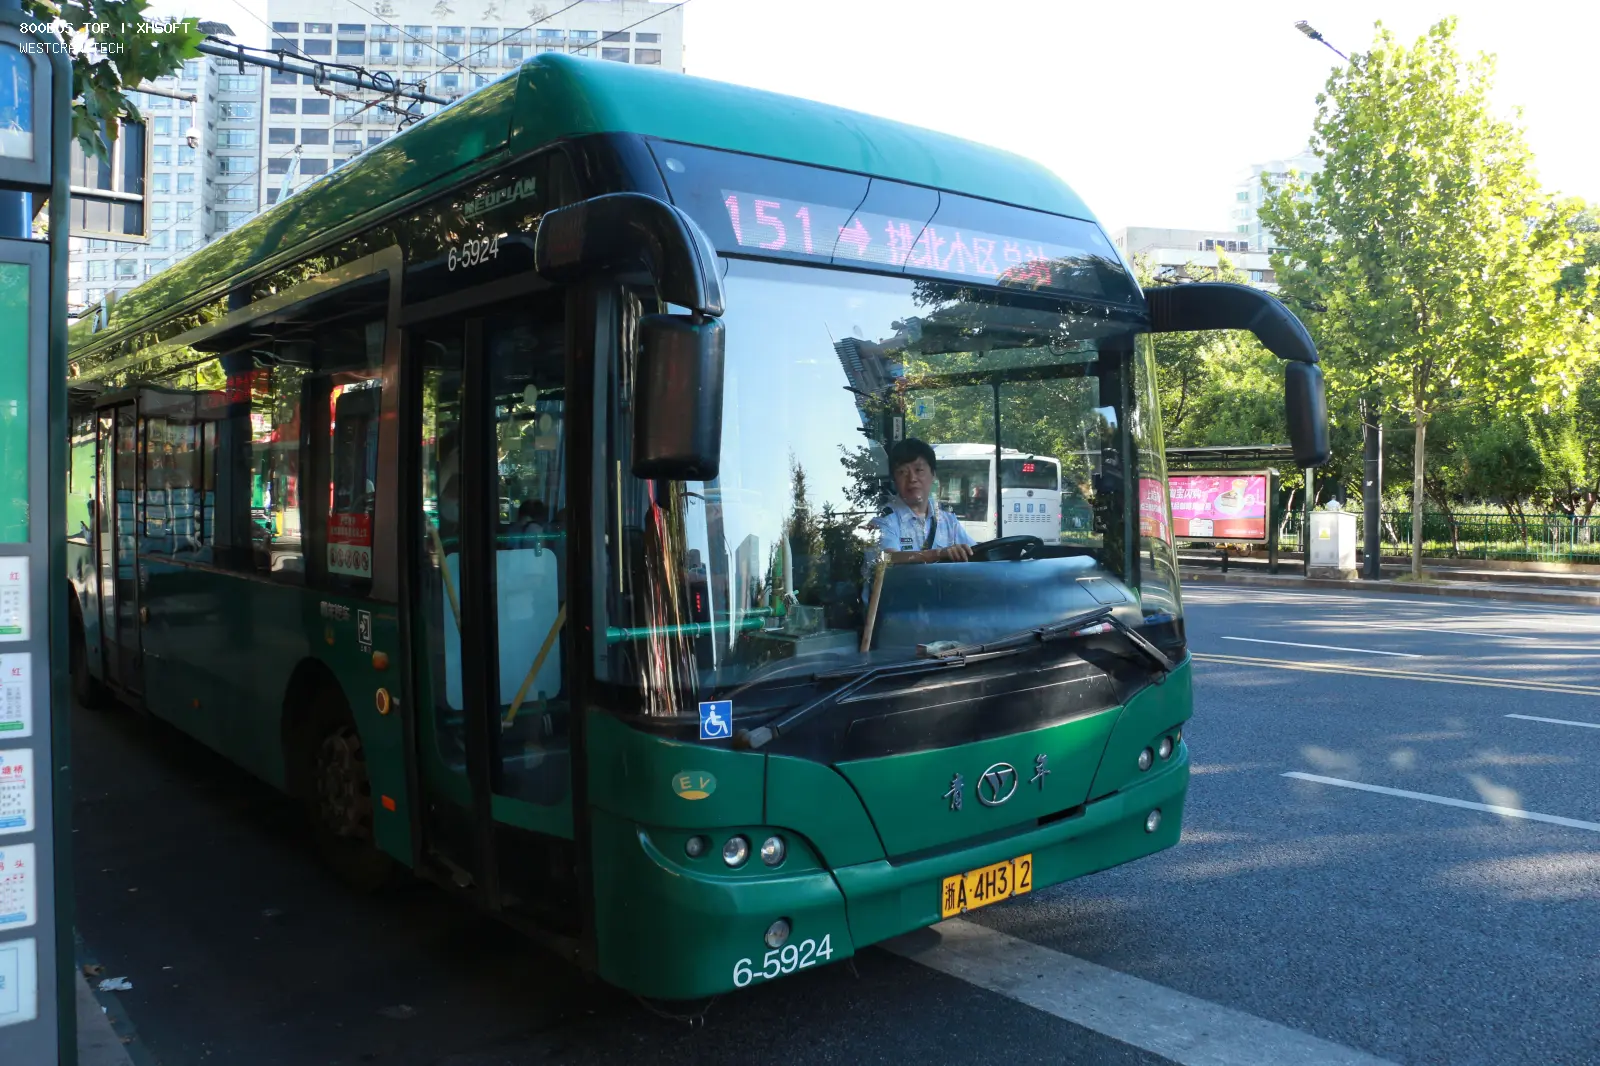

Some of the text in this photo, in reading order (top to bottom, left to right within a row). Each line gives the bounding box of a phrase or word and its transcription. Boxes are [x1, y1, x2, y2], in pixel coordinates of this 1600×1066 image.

[464, 177, 537, 216] NEOPLAN
[725, 194, 815, 255] 151
[448, 233, 500, 272] 6-5924
[733, 933, 834, 988] 6-5924
